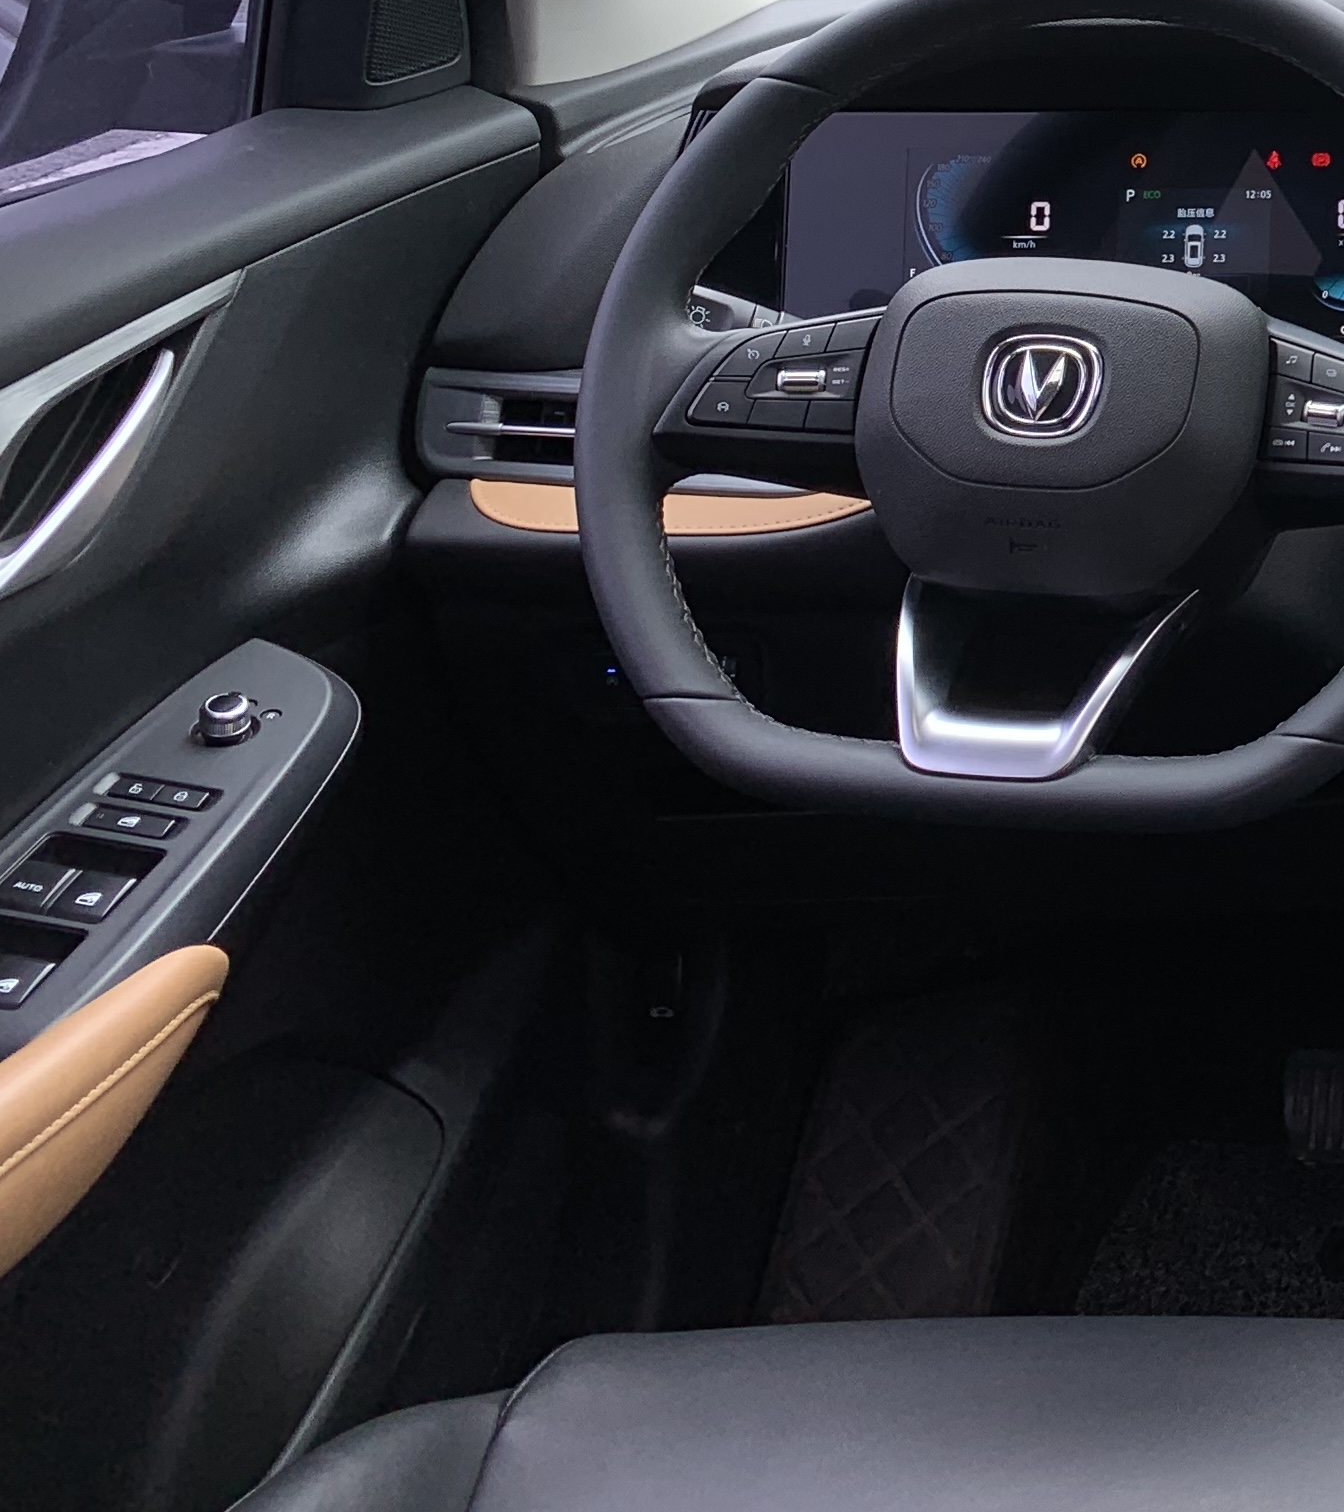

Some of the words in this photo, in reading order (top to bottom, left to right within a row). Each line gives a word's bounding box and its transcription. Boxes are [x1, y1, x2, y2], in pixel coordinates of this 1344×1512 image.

[1126, 189, 1135, 202] P
[1143, 190, 1161, 199] ECO
[1245, 190, 1272, 199] 12:05
[1030, 201, 1050, 231] 0
[1177, 208, 1215, 218] 胎压信息
[1162, 230, 1175, 239] 2.2
[1213, 230, 1227, 239] 2.2
[1013, 240, 1036, 249] km/h
[1161, 254, 1175, 263] 2.3
[1212, 254, 1226, 263] 2.3
[910, 268, 916, 277] F
[1322, 290, 1329, 299] 0
[13, 881, 44, 892] AUTO
